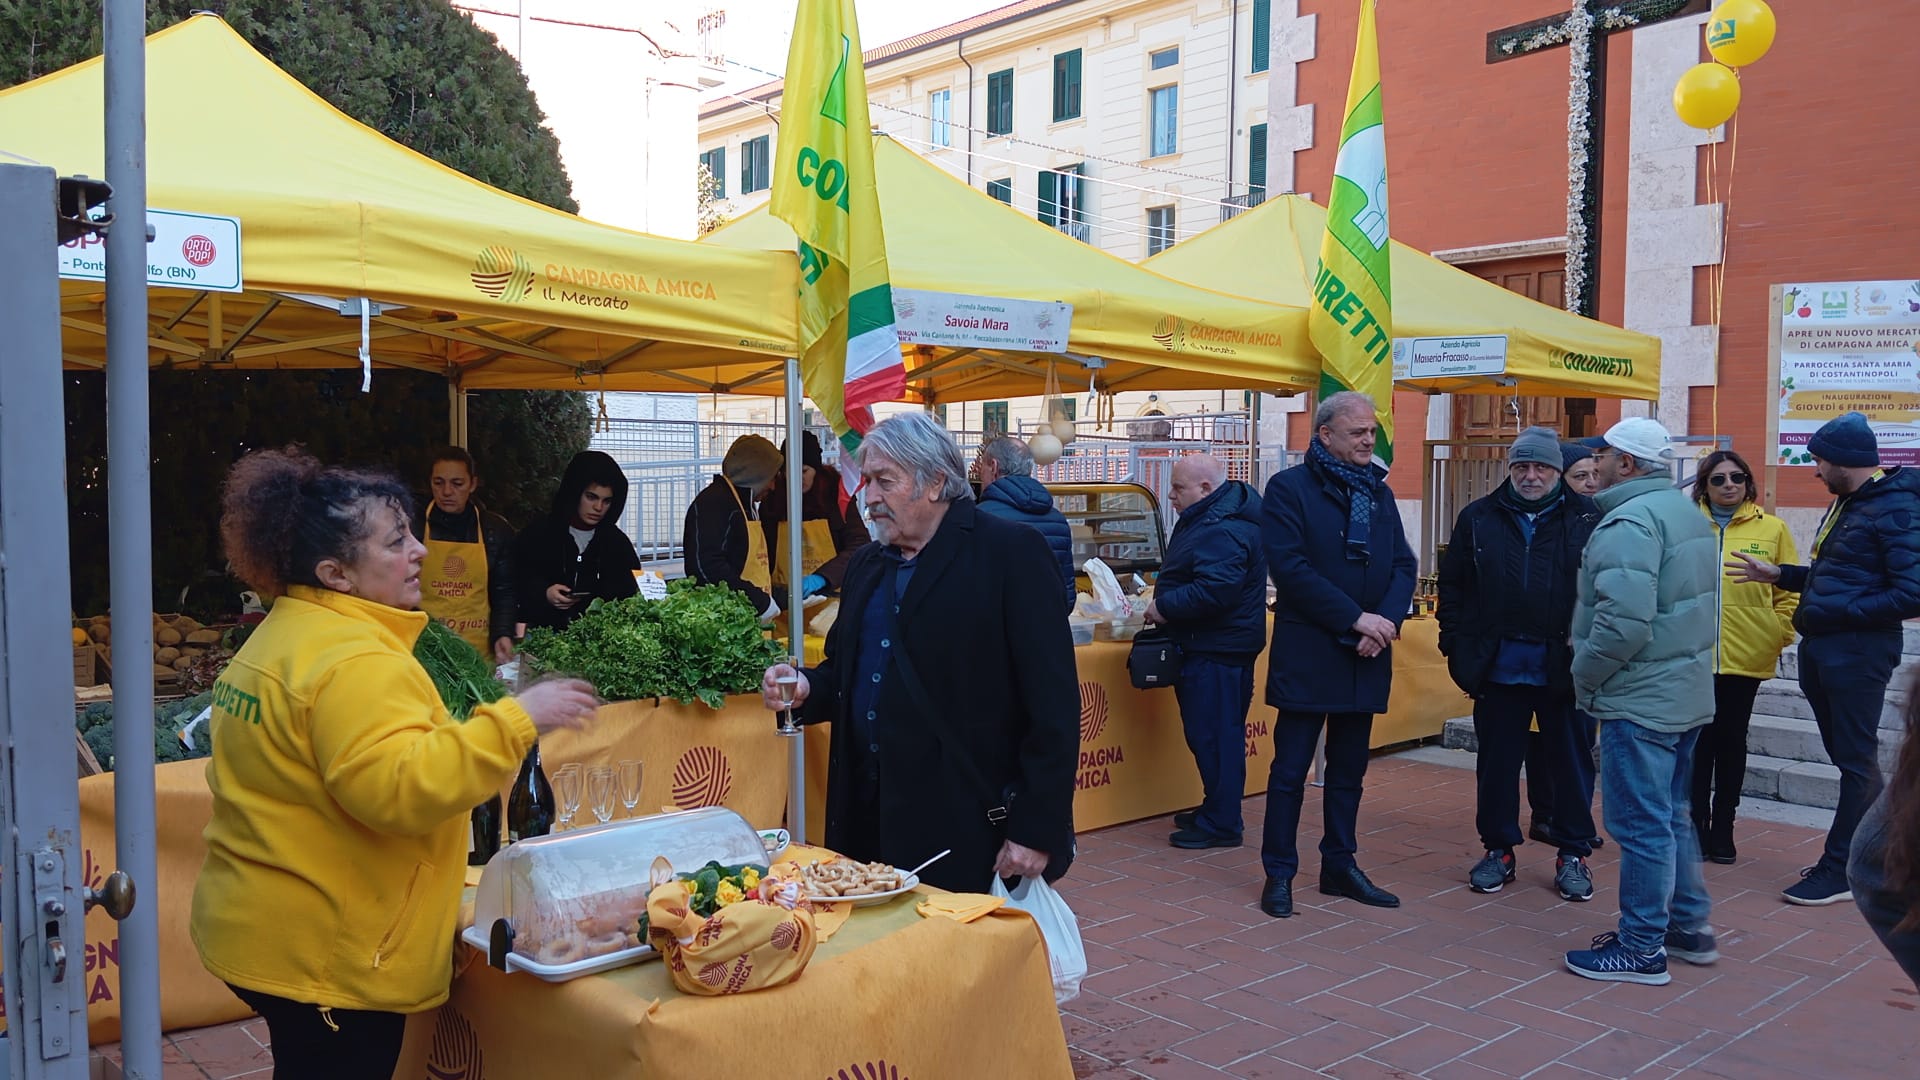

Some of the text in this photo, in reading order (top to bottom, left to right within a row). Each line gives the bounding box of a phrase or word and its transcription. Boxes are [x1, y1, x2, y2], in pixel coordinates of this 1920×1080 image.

[187, 239, 212, 251] ORTO
[188, 250, 211, 263] POP!
[167, 266, 196, 280] (BN)
[545, 263, 717, 300] CAMPAGNA AMICA
[561, 290, 629, 310] Mercato
[944, 315, 1009, 331] Savoia Mara
[1190, 325, 1282, 347] CAMPAGNA AMICA
[1787, 330, 1813, 338] APRE
[1817, 329, 1832, 337] UN
[1835, 329, 1873, 337] NUOVO
[1800, 340, 1909, 349] DI CAMPAGNA AMICA
[1414, 353, 1441, 364] Masseria
[1442, 351, 1469, 362] Fracasso
[1563, 351, 1633, 377] COLDIRETTI
[1795, 403, 1835, 411] GIOVEDÌ
[1847, 403, 1895, 411] FEBBRAIO
[1898, 403, 1920, 411] 2025
[431, 581, 473, 589] CAMPAGNA
[438, 589, 465, 597] AMICA
[1080, 746, 1124, 770] PAGNA
[1074, 768, 1111, 791] MICA
[721, 954, 749, 994] AMPAGNA
